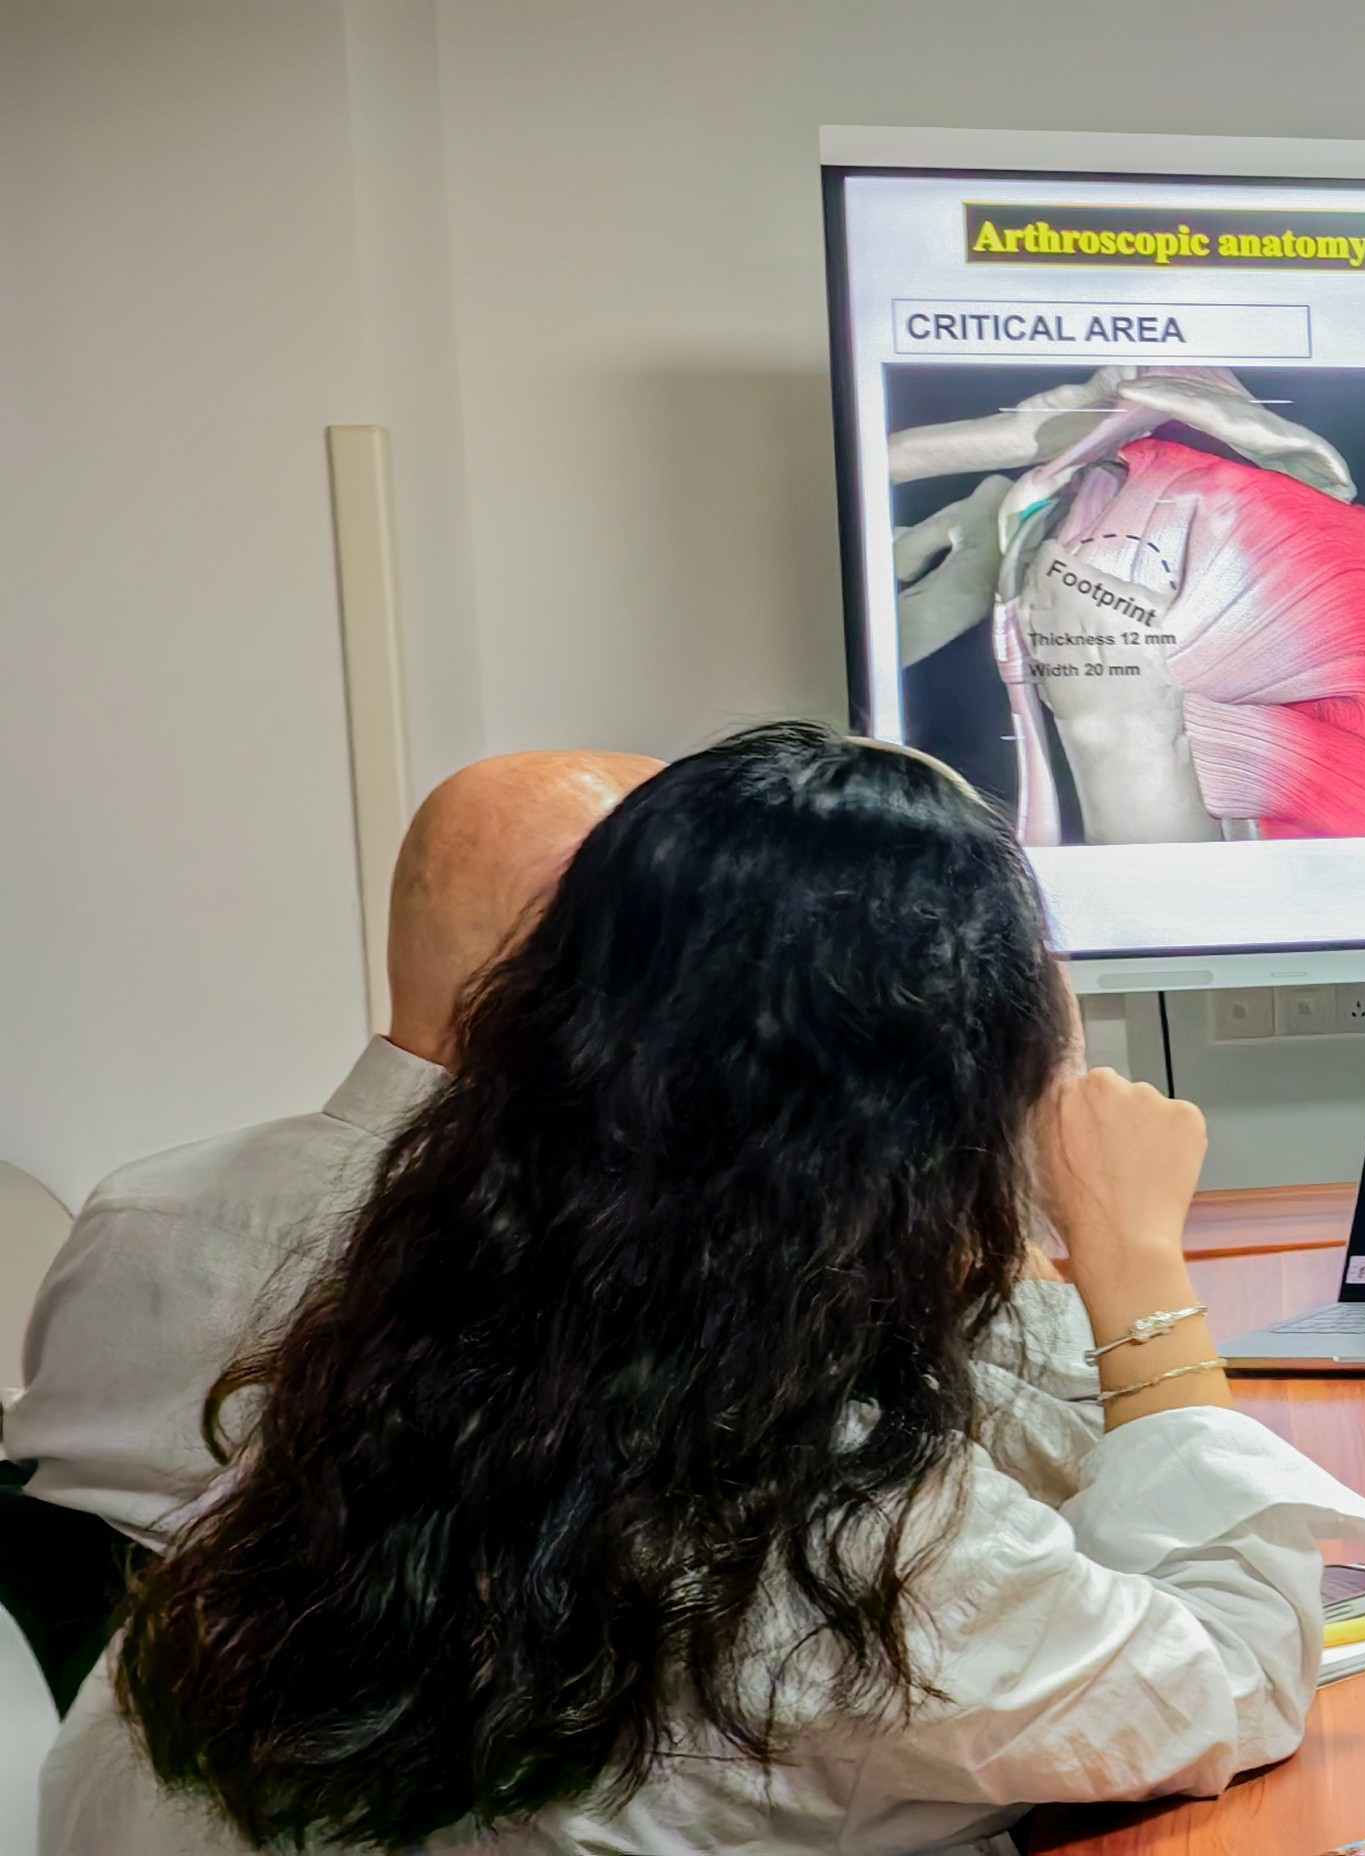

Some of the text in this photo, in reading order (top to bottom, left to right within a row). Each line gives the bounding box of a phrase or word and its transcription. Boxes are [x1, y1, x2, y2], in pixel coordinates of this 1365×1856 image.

[973, 221, 1210, 264] Arthroscopic
[907, 313, 1186, 344] CRITICAL AREA
[1046, 560, 1157, 627] Footprint
[1028, 632, 1177, 647] Thickness 12 mm
[1029, 663, 1141, 677] Width 20 mm
